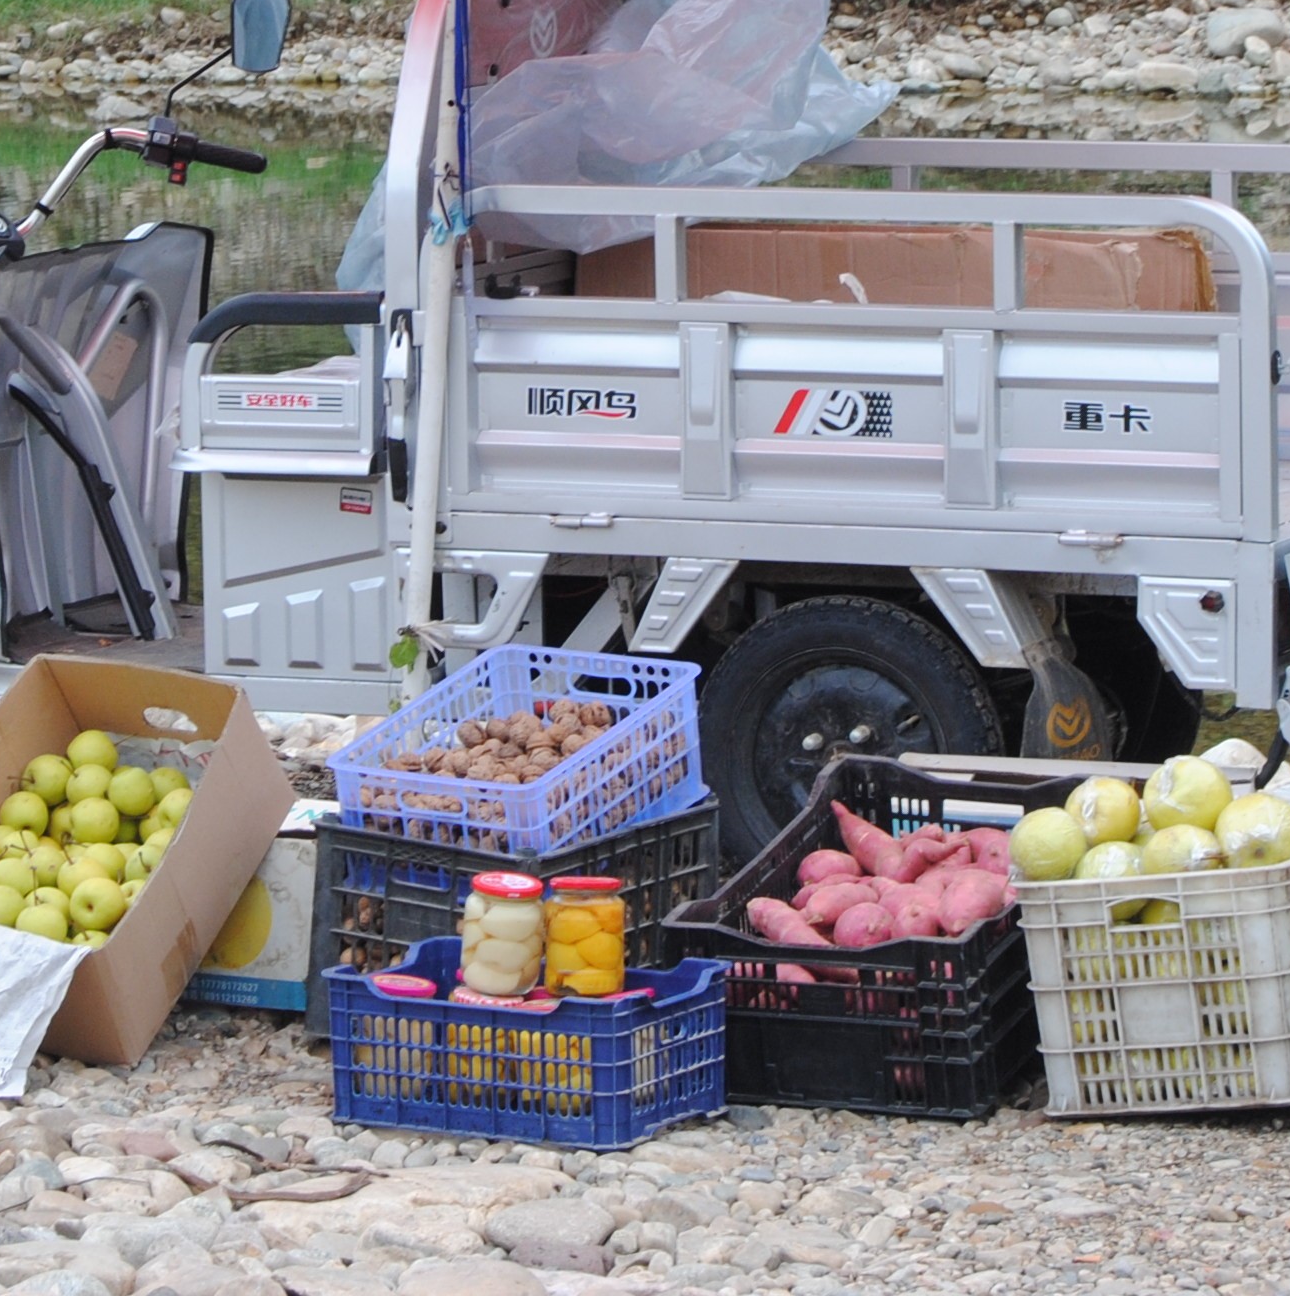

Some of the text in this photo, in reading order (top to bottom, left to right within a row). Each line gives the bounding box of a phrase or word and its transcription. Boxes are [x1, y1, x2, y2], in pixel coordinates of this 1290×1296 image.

[246, 393, 314, 408] 安全好车
[527, 387, 637, 419] 顺风鸟
[1063, 401, 1152, 432] 重卡
